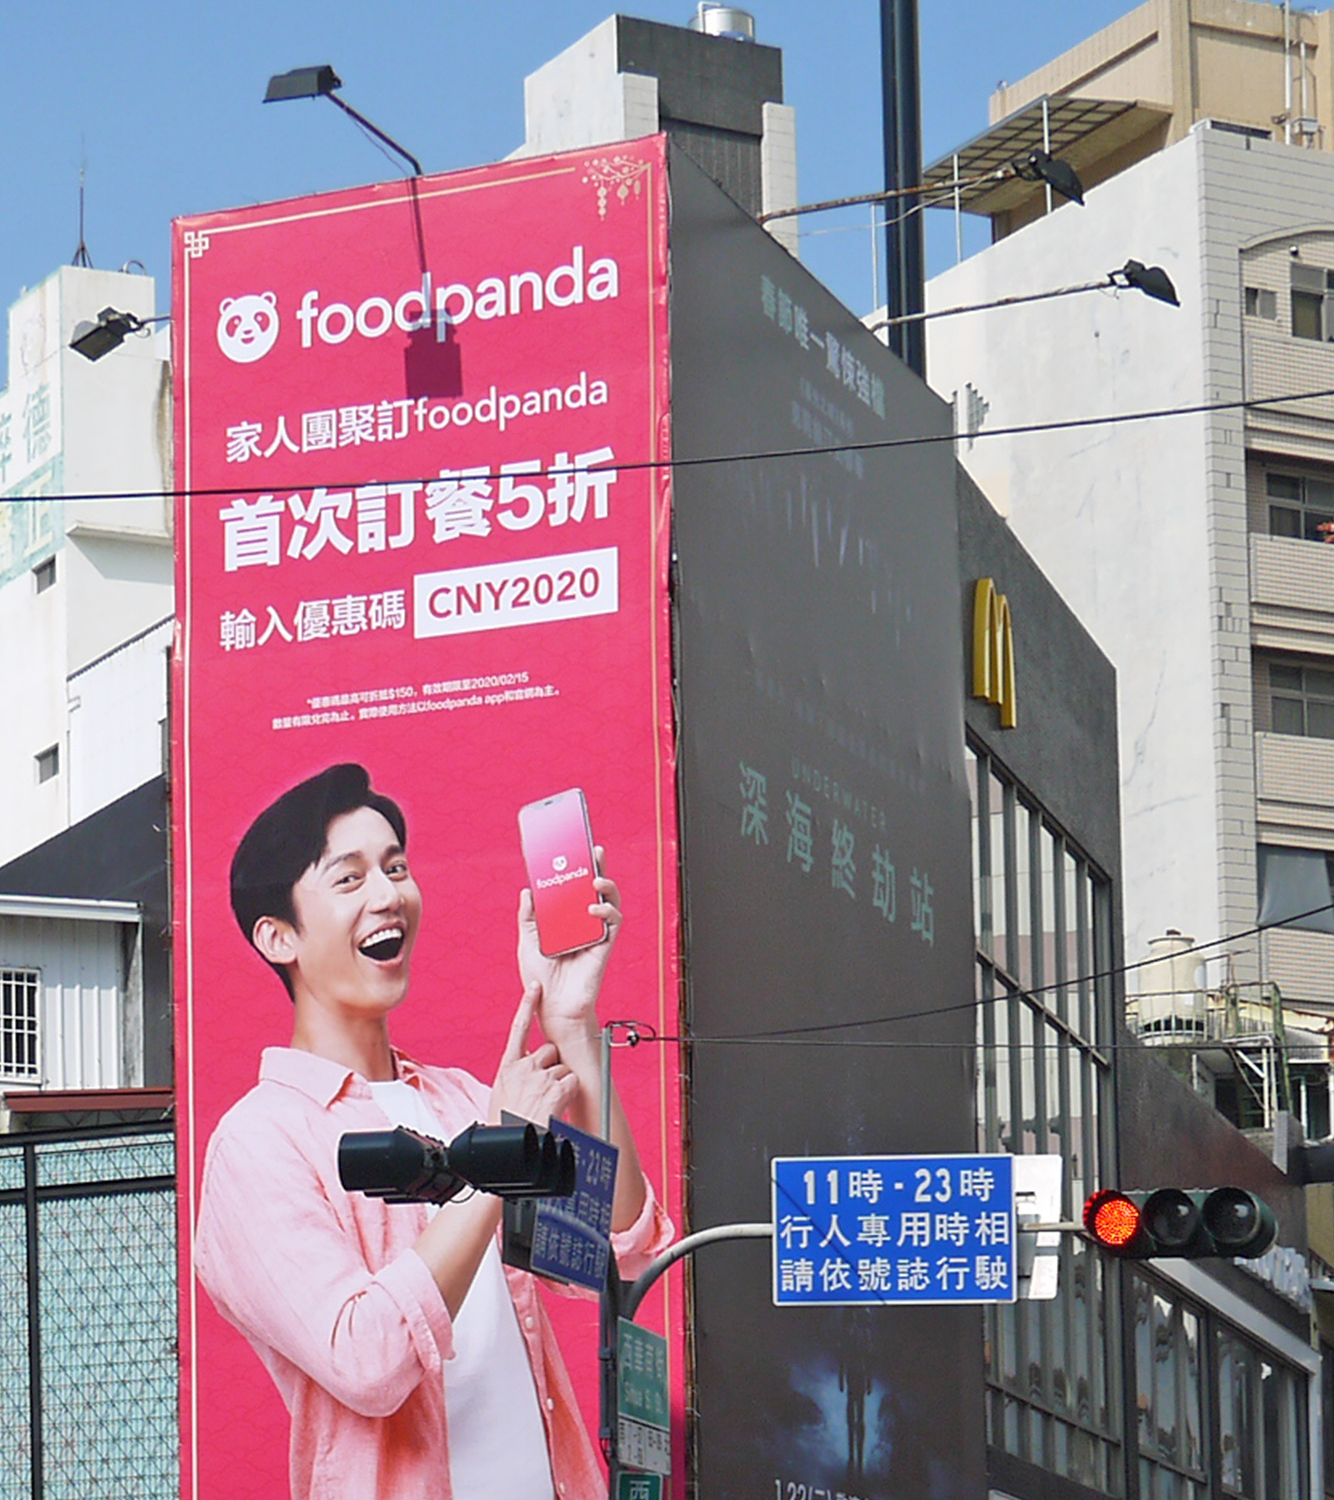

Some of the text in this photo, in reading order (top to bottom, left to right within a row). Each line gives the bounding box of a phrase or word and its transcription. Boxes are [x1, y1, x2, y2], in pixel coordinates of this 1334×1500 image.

[296, 247, 619, 348] foodpanda
[219, 447, 619, 572] 首次訂餐5折
[428, 567, 600, 618] CNY2020
[220, 592, 406, 651] 輸入優惠碼
[537, 867, 588, 889] foodpanda
[780, 1212, 1010, 1249] 行人專用時相
[780, 1256, 1009, 1292] 請依號誌行駛
